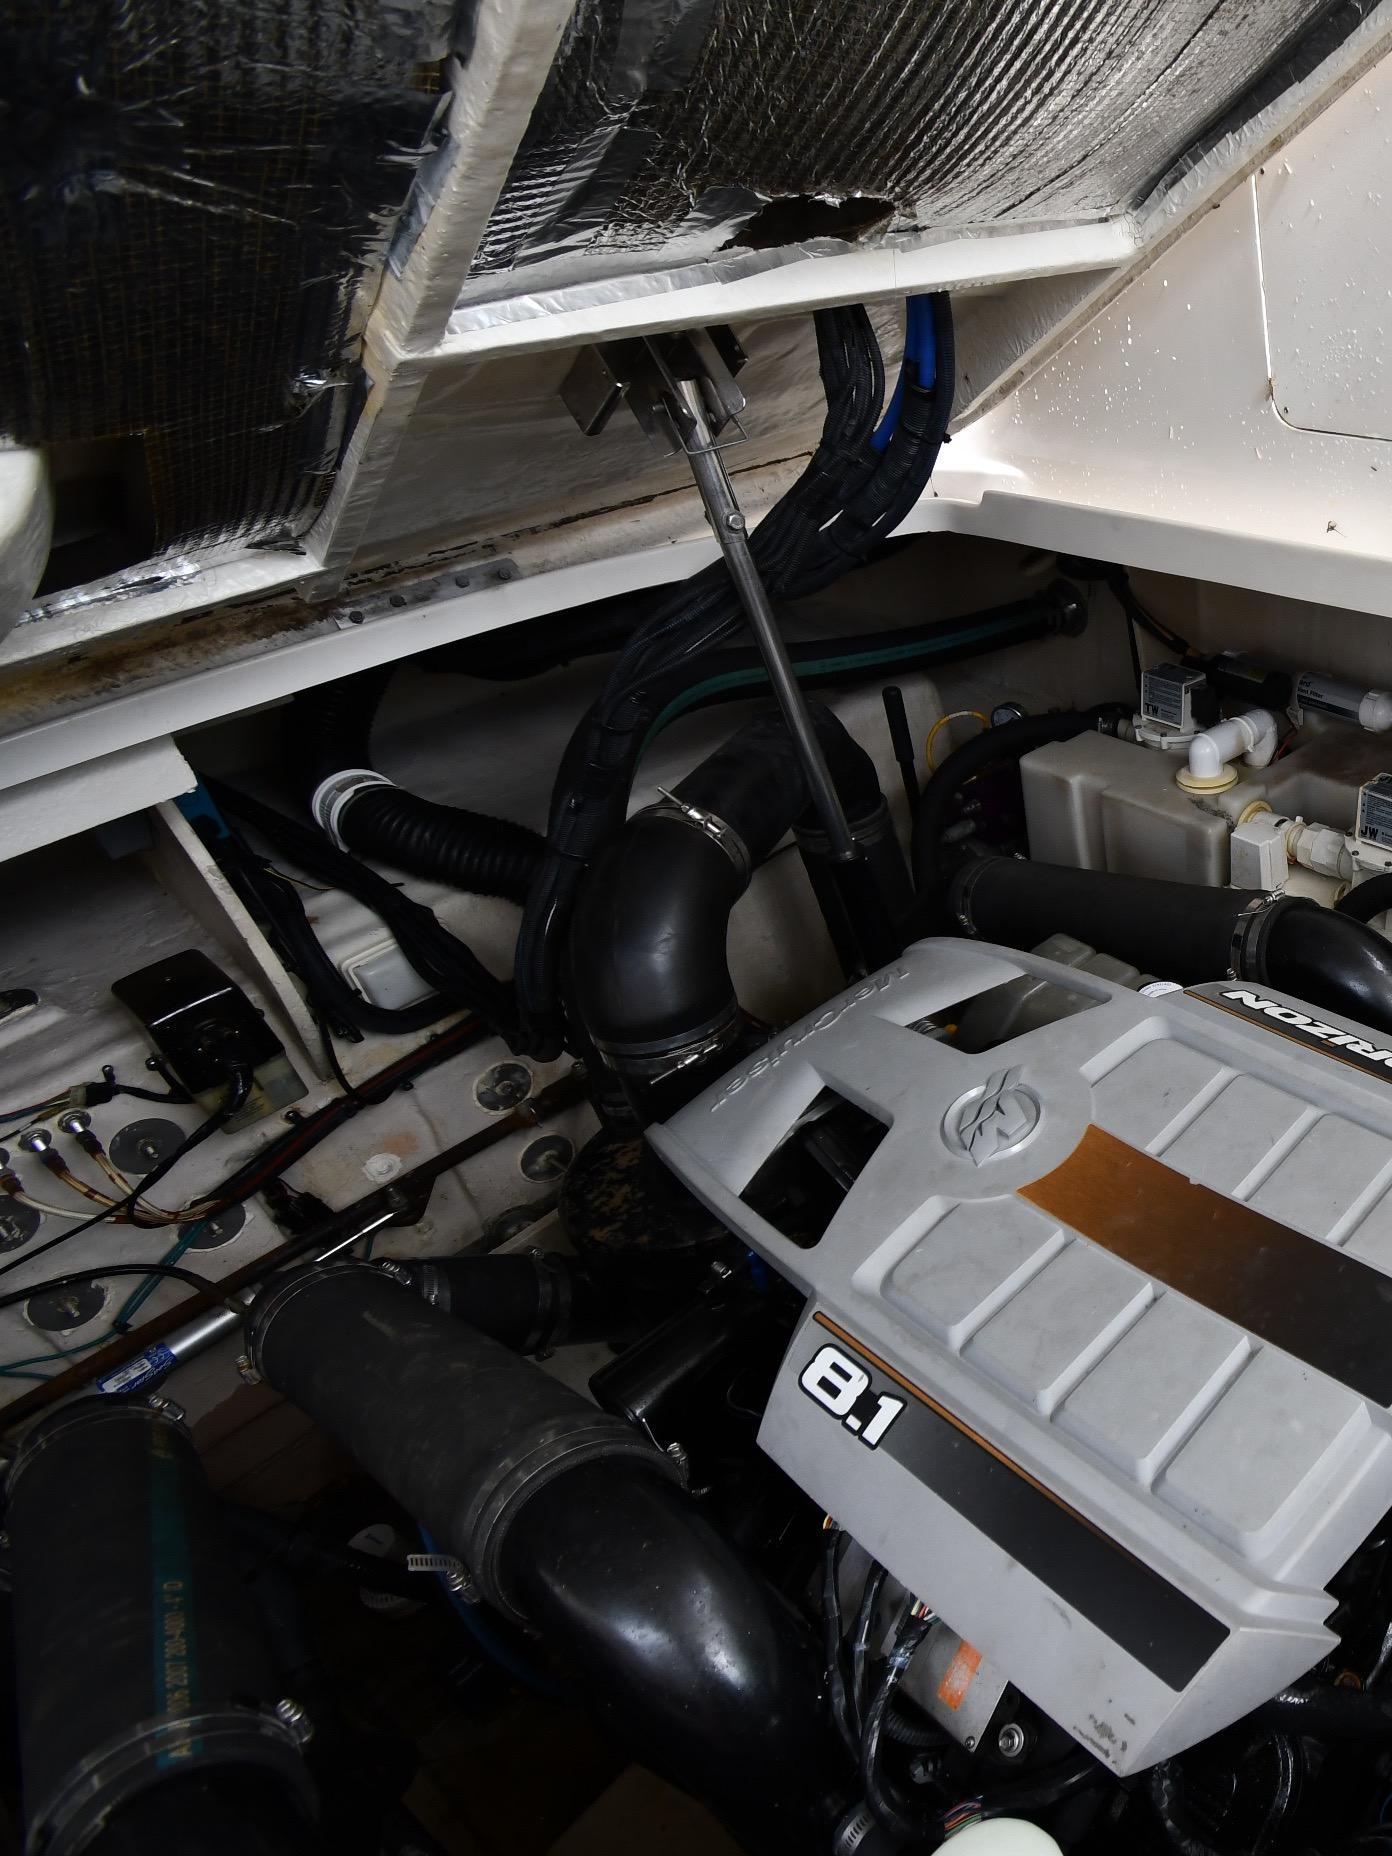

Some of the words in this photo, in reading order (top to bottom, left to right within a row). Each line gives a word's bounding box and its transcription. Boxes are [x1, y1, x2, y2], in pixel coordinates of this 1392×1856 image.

[1145, 702, 1159, 717] TW
[1360, 825, 1379, 842] JW
[800, 1345, 905, 1447] 8.1
